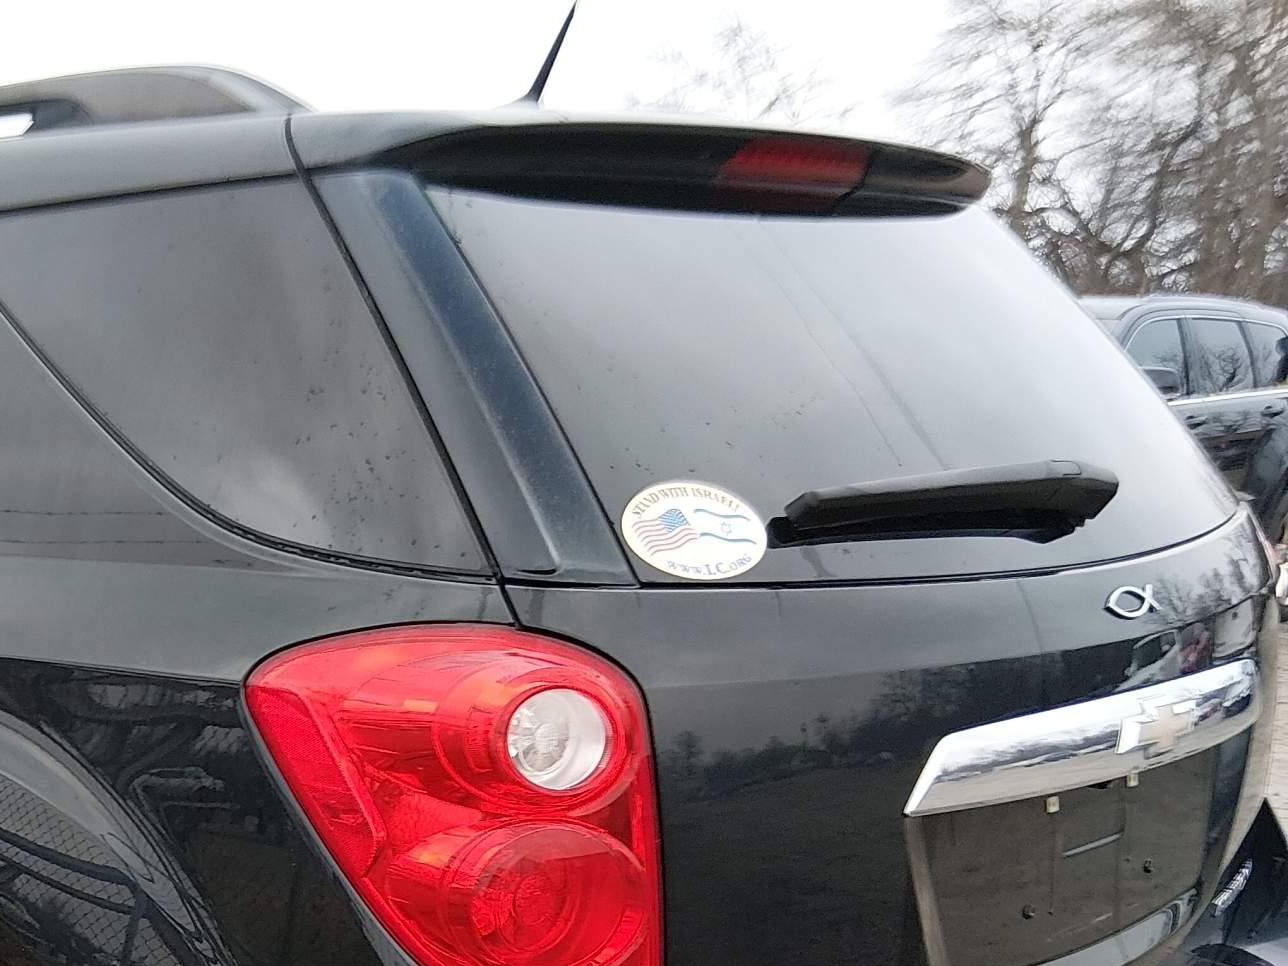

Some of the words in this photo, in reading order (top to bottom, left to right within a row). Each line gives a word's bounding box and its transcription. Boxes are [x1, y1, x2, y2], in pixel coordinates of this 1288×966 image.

[632, 492, 660, 519] STAND
[659, 487, 689, 499] WITH
[691, 487, 740, 513] ISRAEL
